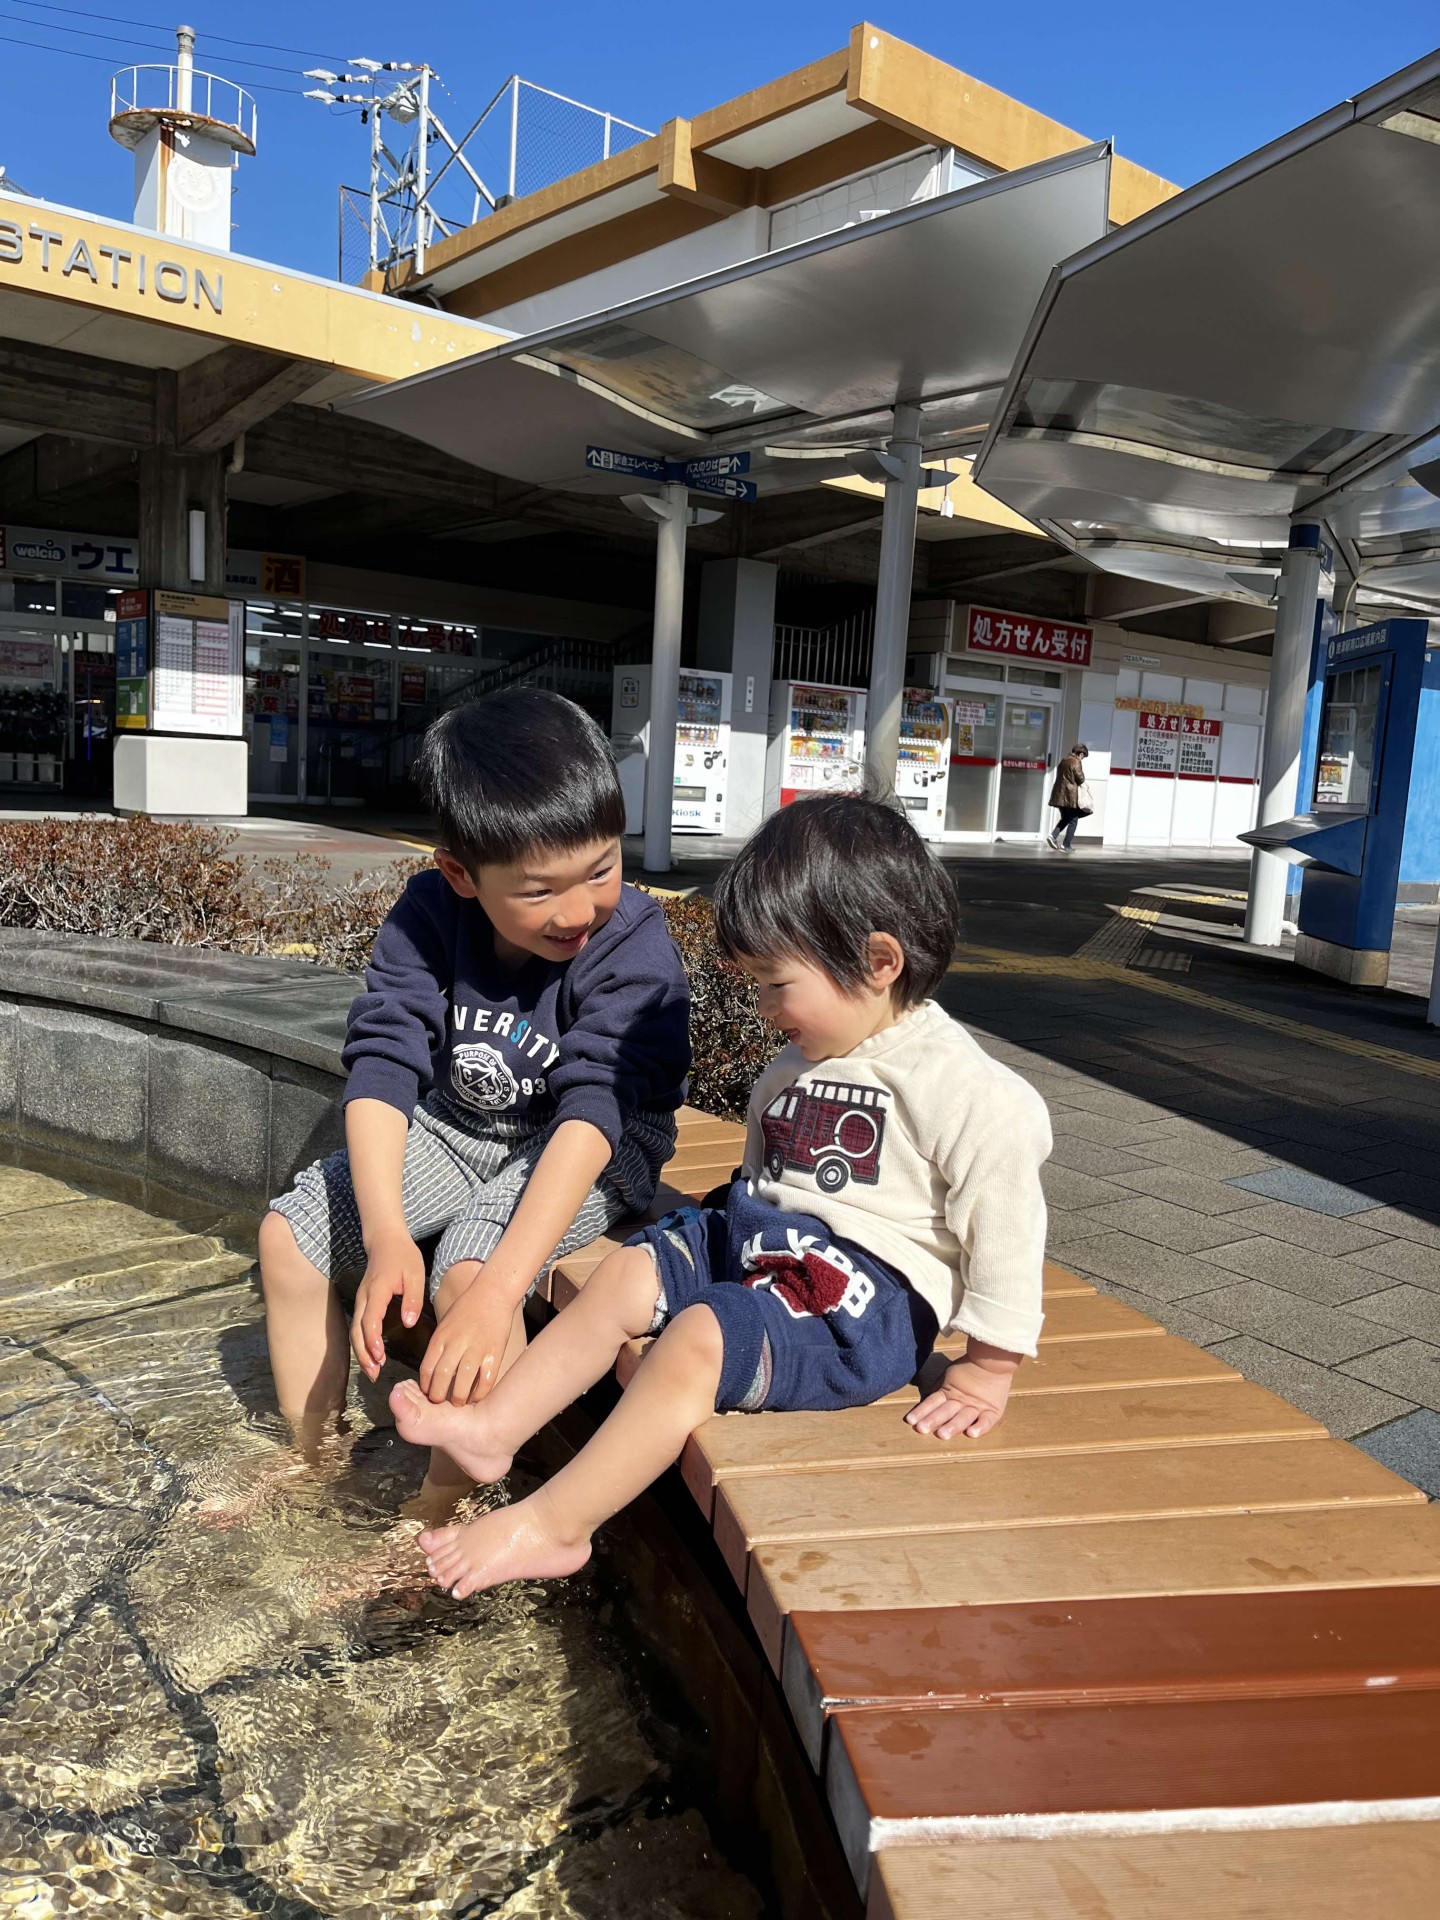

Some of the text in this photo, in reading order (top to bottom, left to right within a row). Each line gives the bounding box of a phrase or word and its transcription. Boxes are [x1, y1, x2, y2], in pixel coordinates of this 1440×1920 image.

[0, 219, 222, 314] STATION
[614, 454, 664, 472] 駅舎エレベーター
[686, 459, 718, 474] バスのりば
[16, 540, 61, 560] welcia
[264, 557, 301, 594] 酒
[318, 611, 468, 654] 処方せん受付
[973, 615, 1087, 660] 処方せん受付
[1147, 714, 1211, 735] 処方せん受付
[672, 808, 701, 817] Kiosk
[458, 1050, 491, 1064] PURPOSE
[488, 1058, 498, 1068] OF
[497, 1071, 509, 1085] LIFE
[521, 1077, 546, 1095] 93
